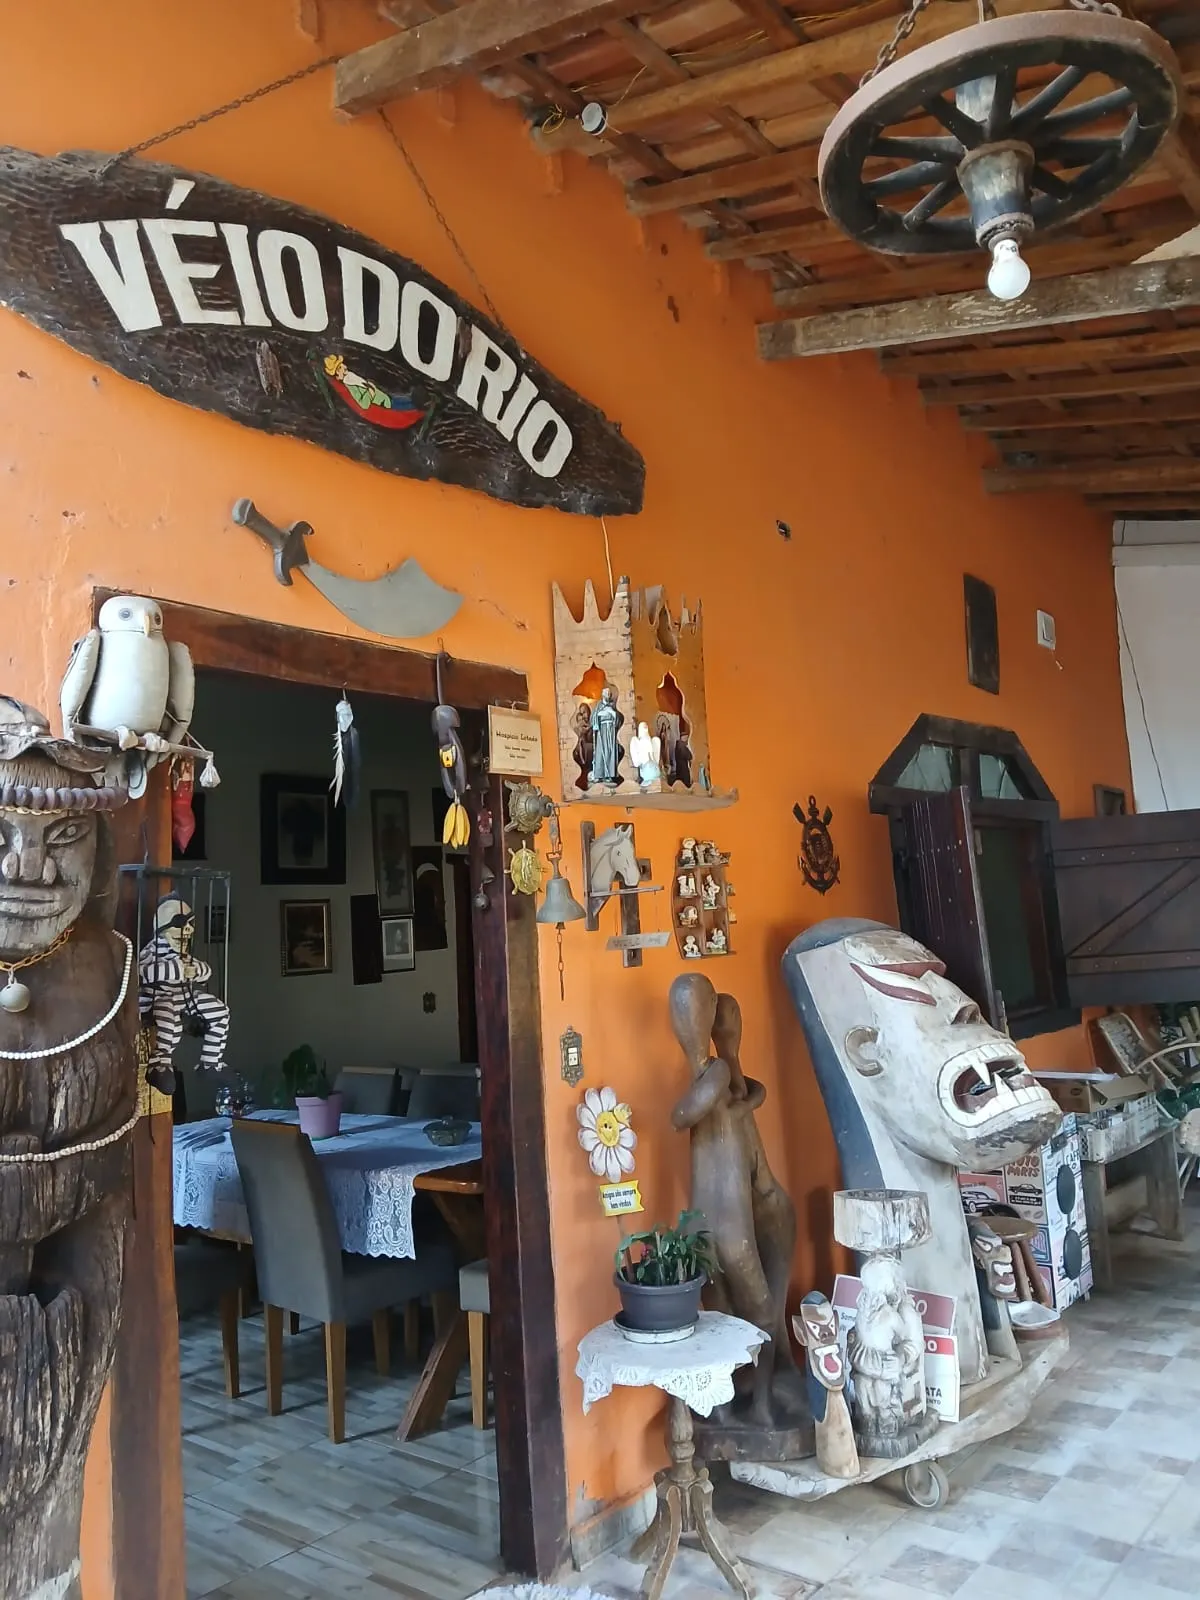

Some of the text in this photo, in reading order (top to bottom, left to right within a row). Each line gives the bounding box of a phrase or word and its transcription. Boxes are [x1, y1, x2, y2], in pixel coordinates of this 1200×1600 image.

[60, 178, 574, 479] VÉIO DO RIO
[1011, 1155, 1040, 1167] UTO
[1007, 1166, 1040, 1178] PARTS
